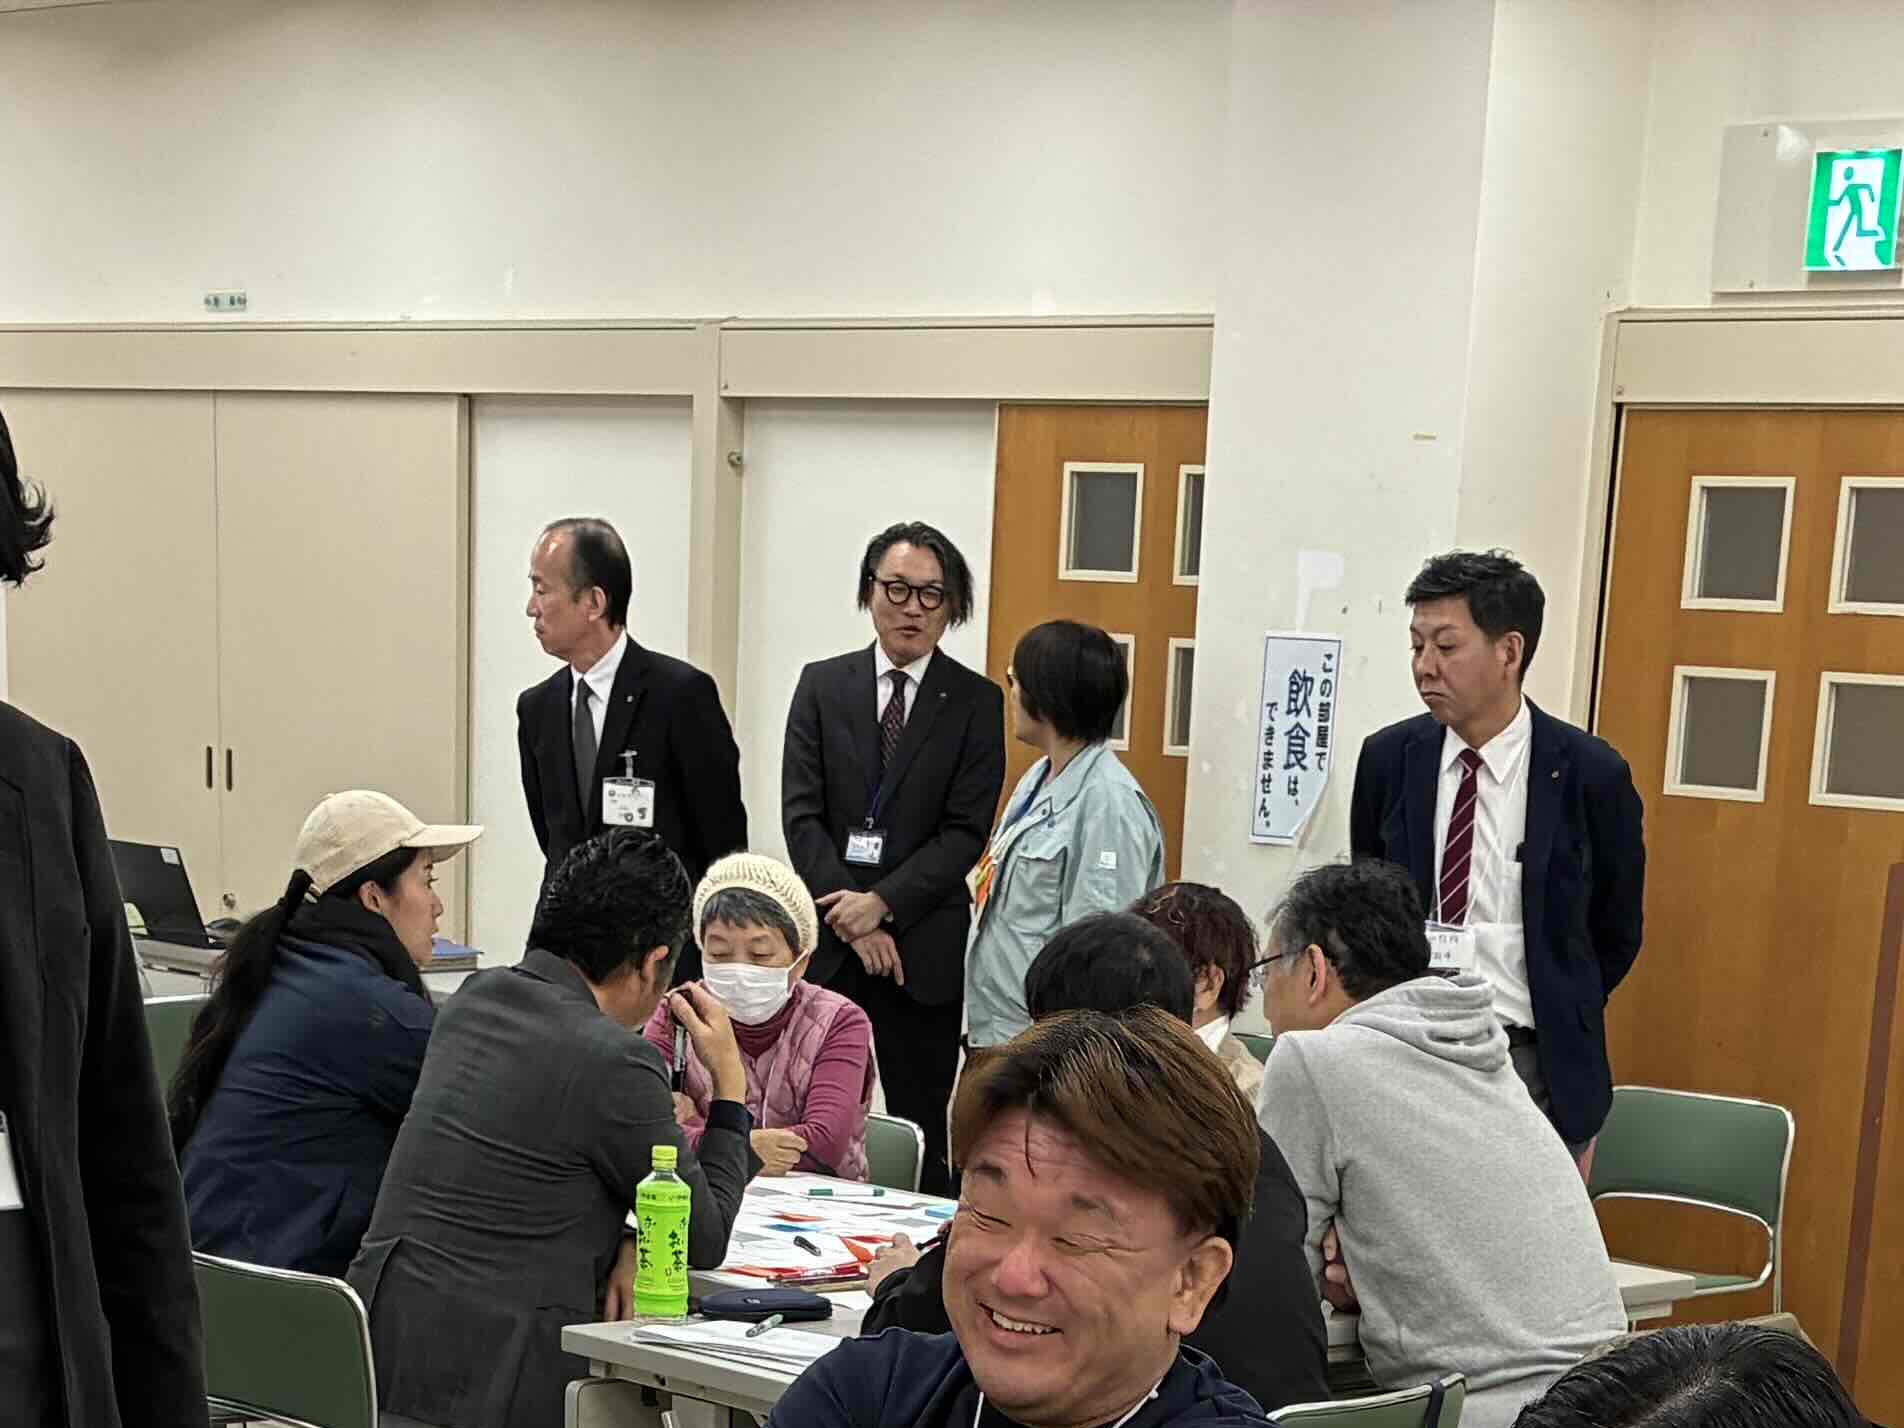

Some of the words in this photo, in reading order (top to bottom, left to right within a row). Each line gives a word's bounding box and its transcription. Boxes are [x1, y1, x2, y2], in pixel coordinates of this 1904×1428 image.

[1258, 701, 1279, 829] できません。
[1283, 668, 1315, 807] 飲食は、
